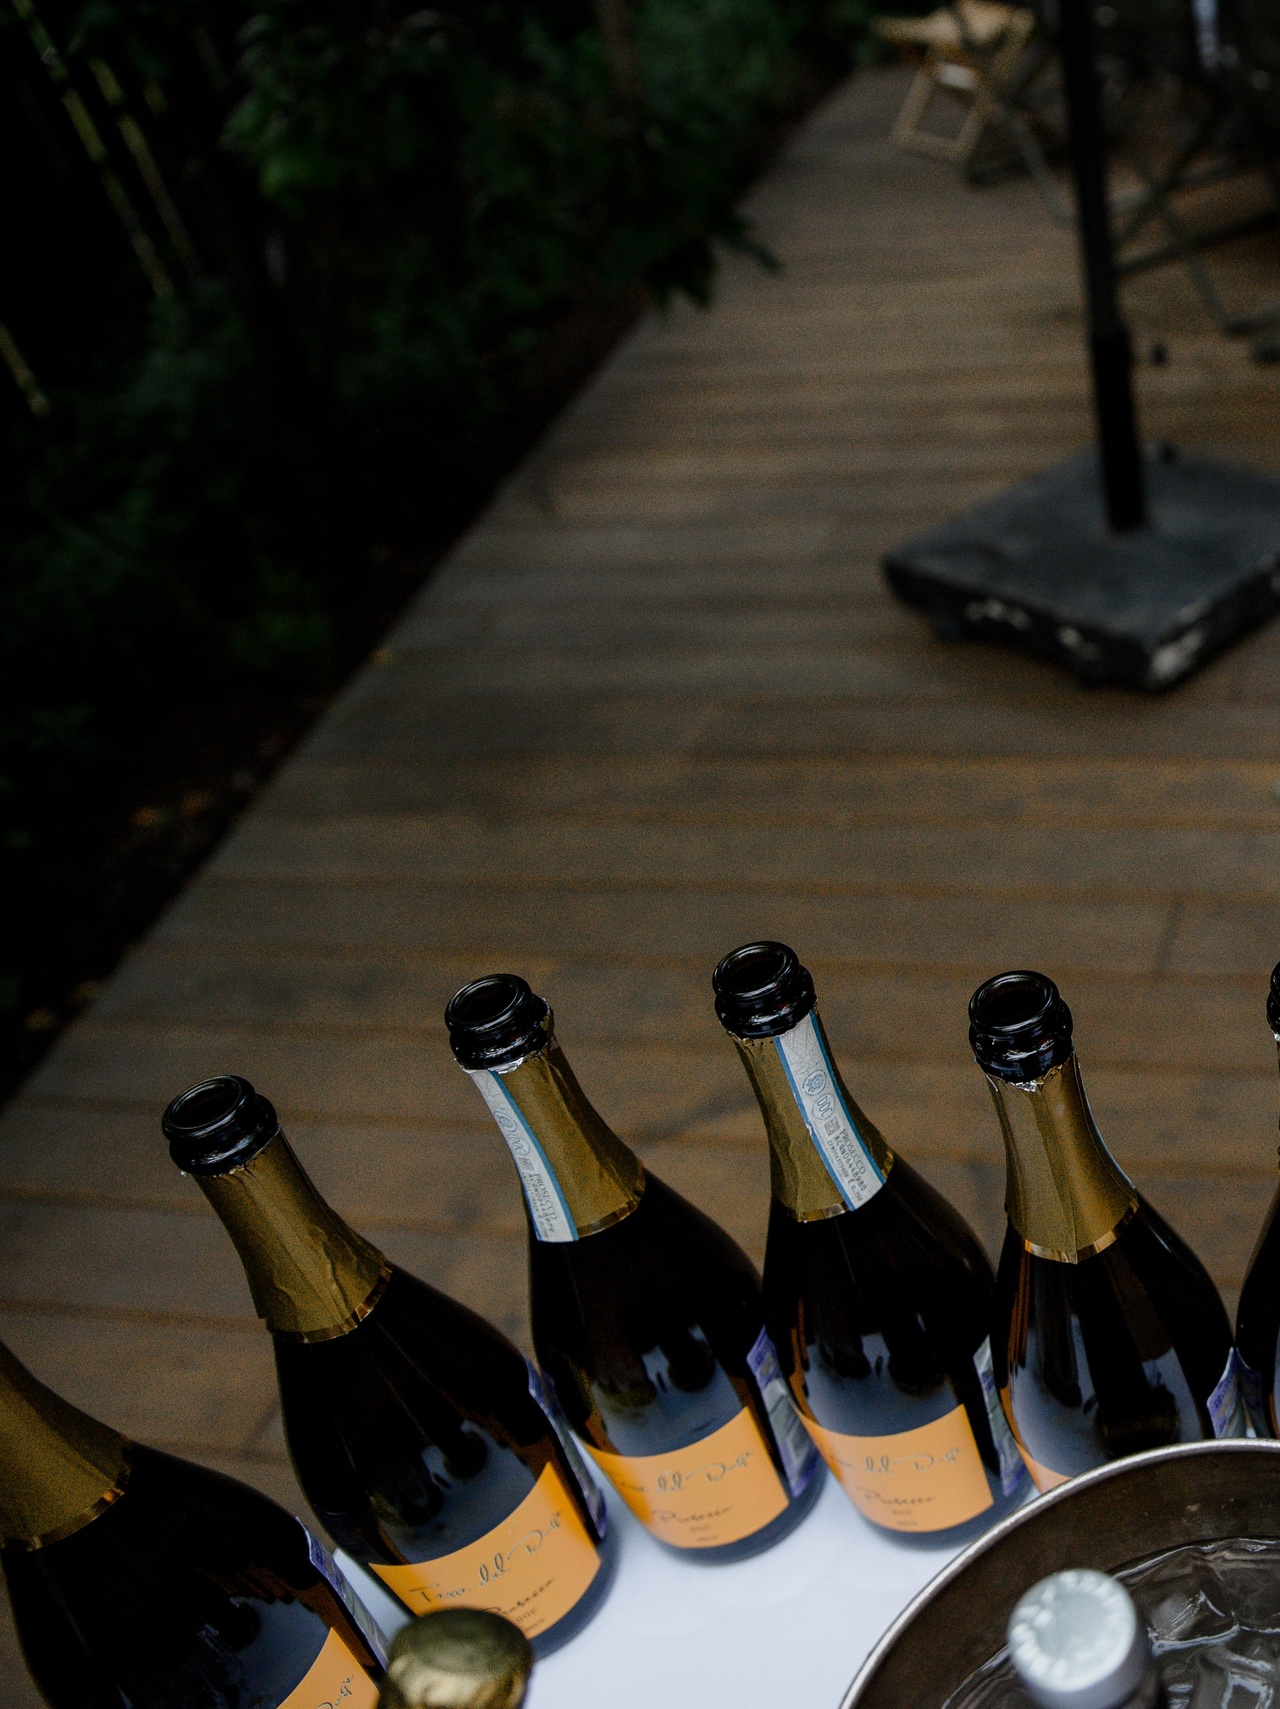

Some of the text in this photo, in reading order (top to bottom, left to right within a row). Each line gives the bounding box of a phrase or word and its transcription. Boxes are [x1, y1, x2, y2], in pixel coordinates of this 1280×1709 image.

[815, 1095, 833, 1118] DOC
[839, 1128, 867, 1175] PROSECCO
[533, 1173, 558, 1220] PROSECCO
